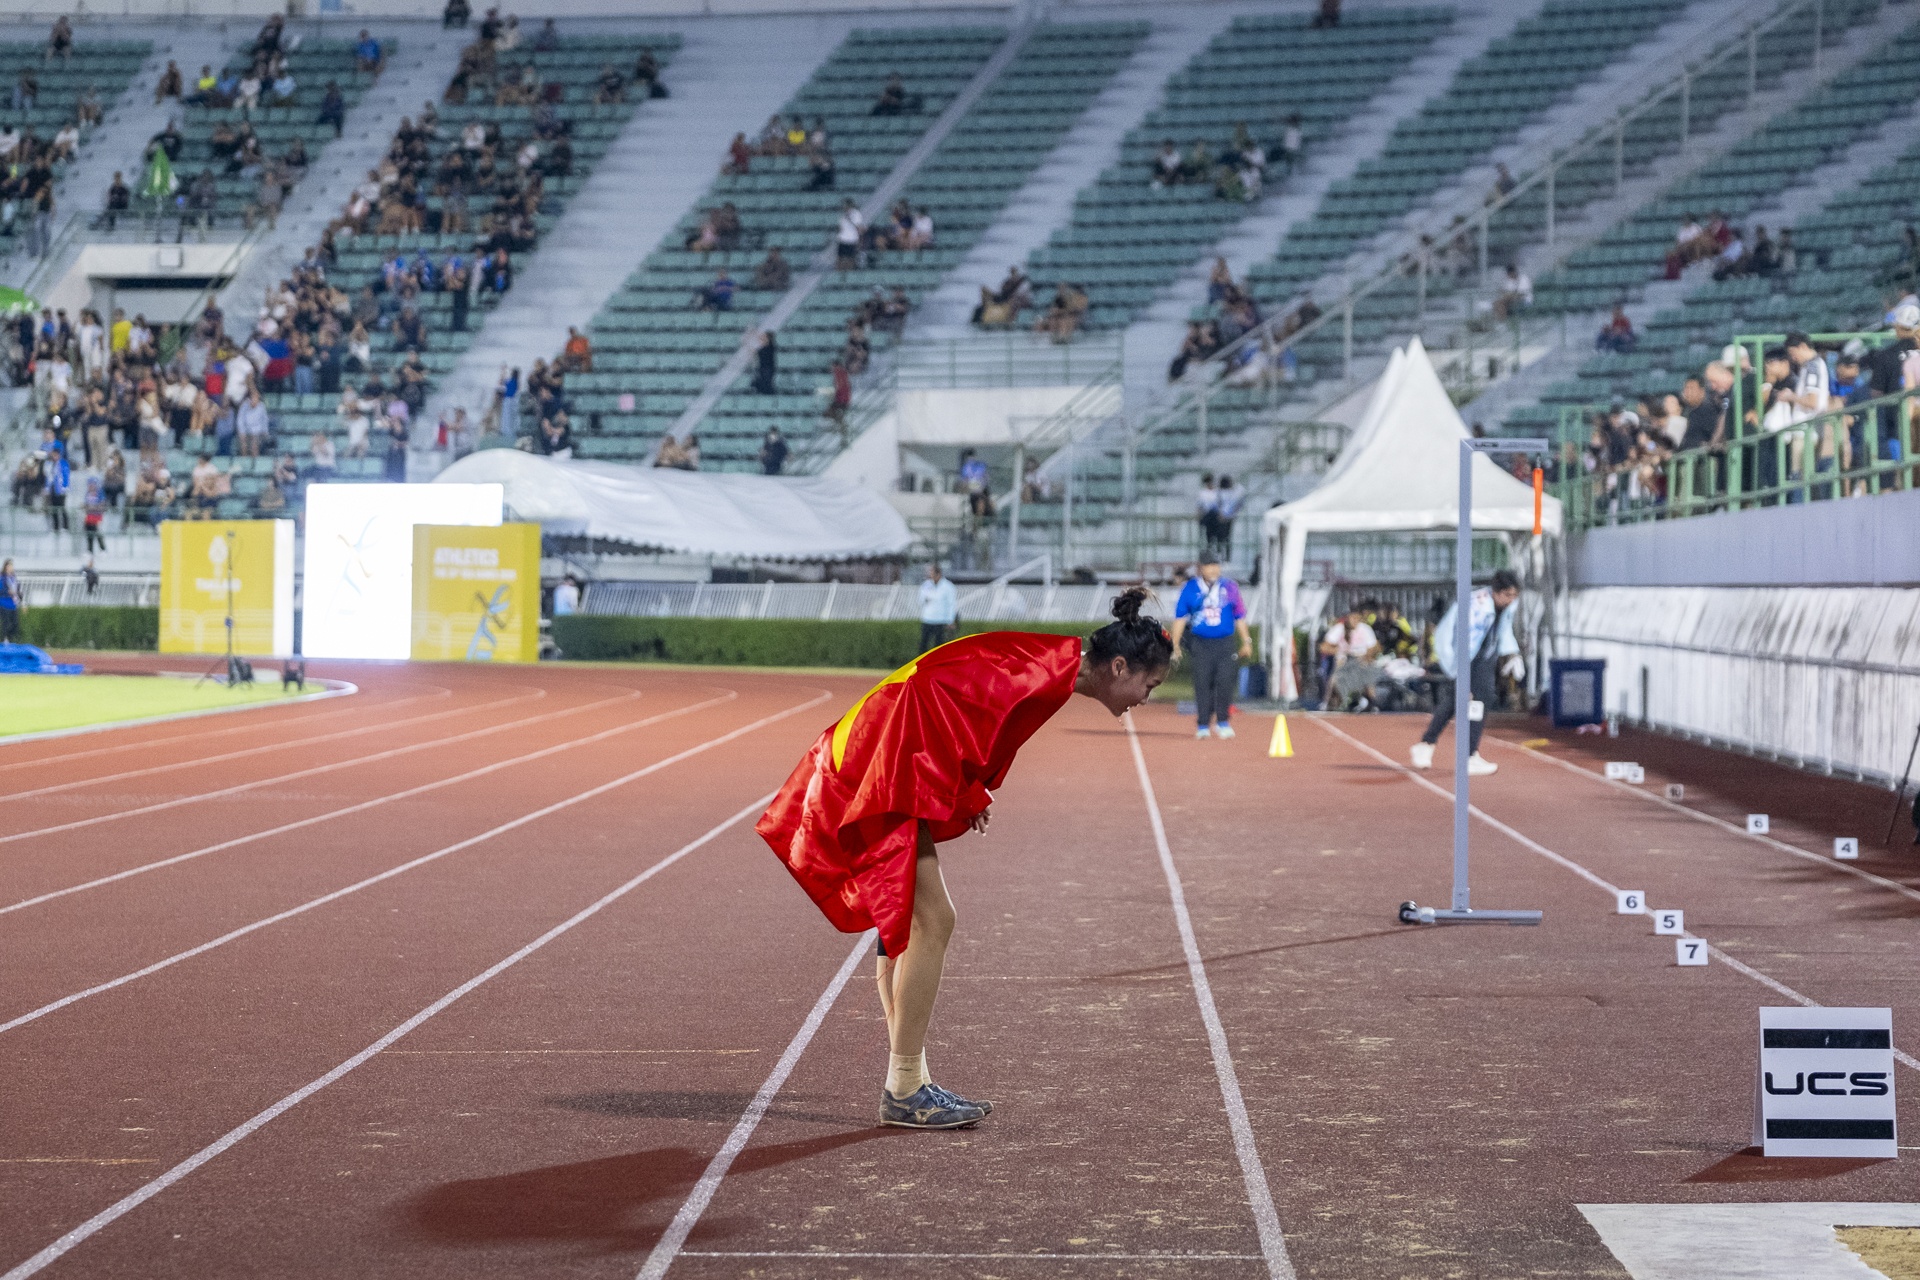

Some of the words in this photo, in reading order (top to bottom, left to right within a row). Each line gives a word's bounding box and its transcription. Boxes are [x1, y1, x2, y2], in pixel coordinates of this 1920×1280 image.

[1841, 842, 1852, 853] 4
[1626, 895, 1638, 909] 6
[1663, 915, 1676, 929] 5
[1685, 944, 1699, 959] 7
[1764, 1071, 1889, 1096] UCS
